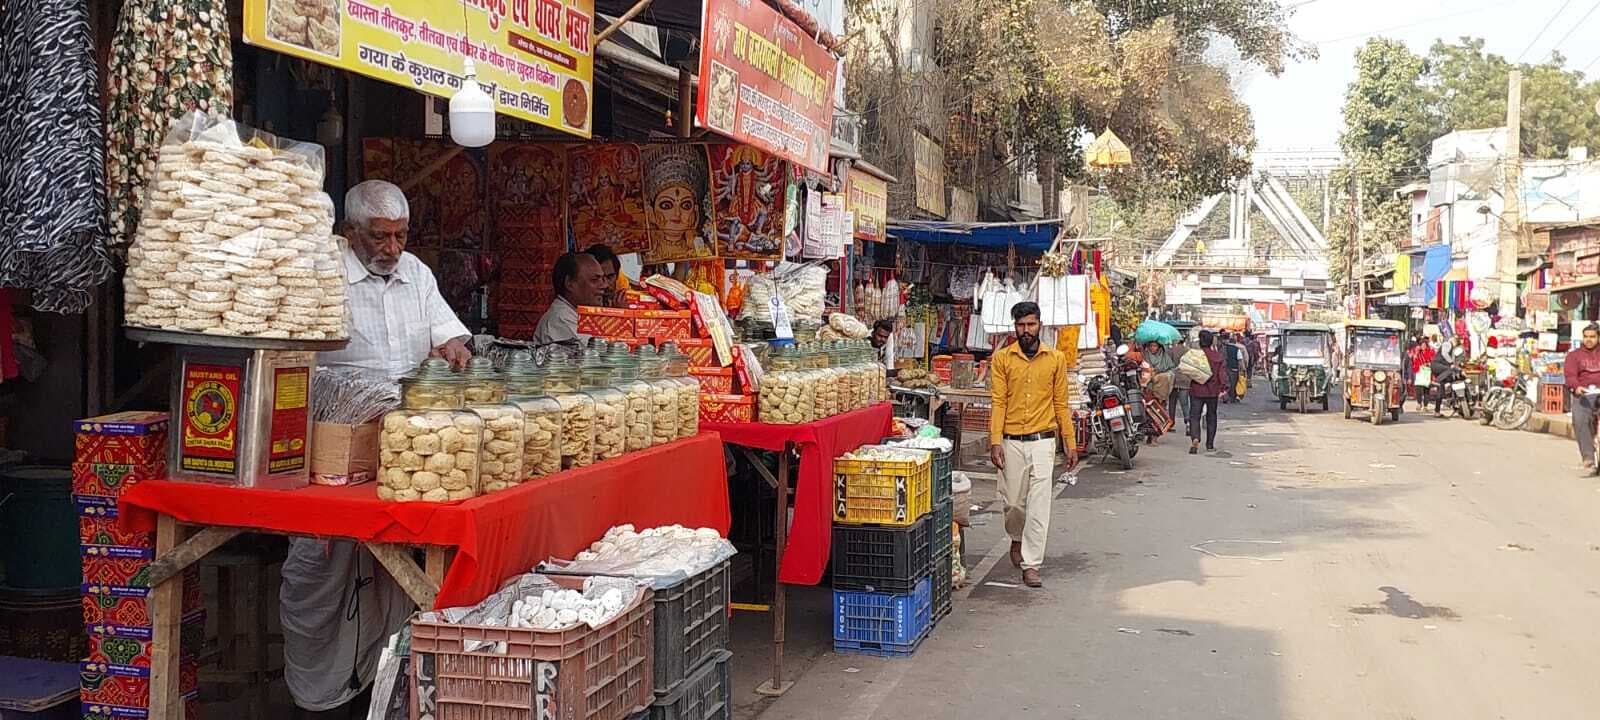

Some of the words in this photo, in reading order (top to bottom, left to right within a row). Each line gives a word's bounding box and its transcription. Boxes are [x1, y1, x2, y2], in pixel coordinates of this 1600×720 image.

[347, 0, 379, 25] खास्ता
[446, 33, 458, 53] एवं
[479, 42, 488, 62] के
[489, 46, 505, 67] थोक
[359, 46, 388, 67] गया
[391, 52, 406, 73] के
[409, 60, 445, 86] कुशल
[499, 87, 519, 109] द्वारा
[520, 91, 550, 117] निर्मित
[189, 371, 223, 379] MUSTARD
[837, 475, 846, 515] KLA
[895, 476, 906, 521] KLA
